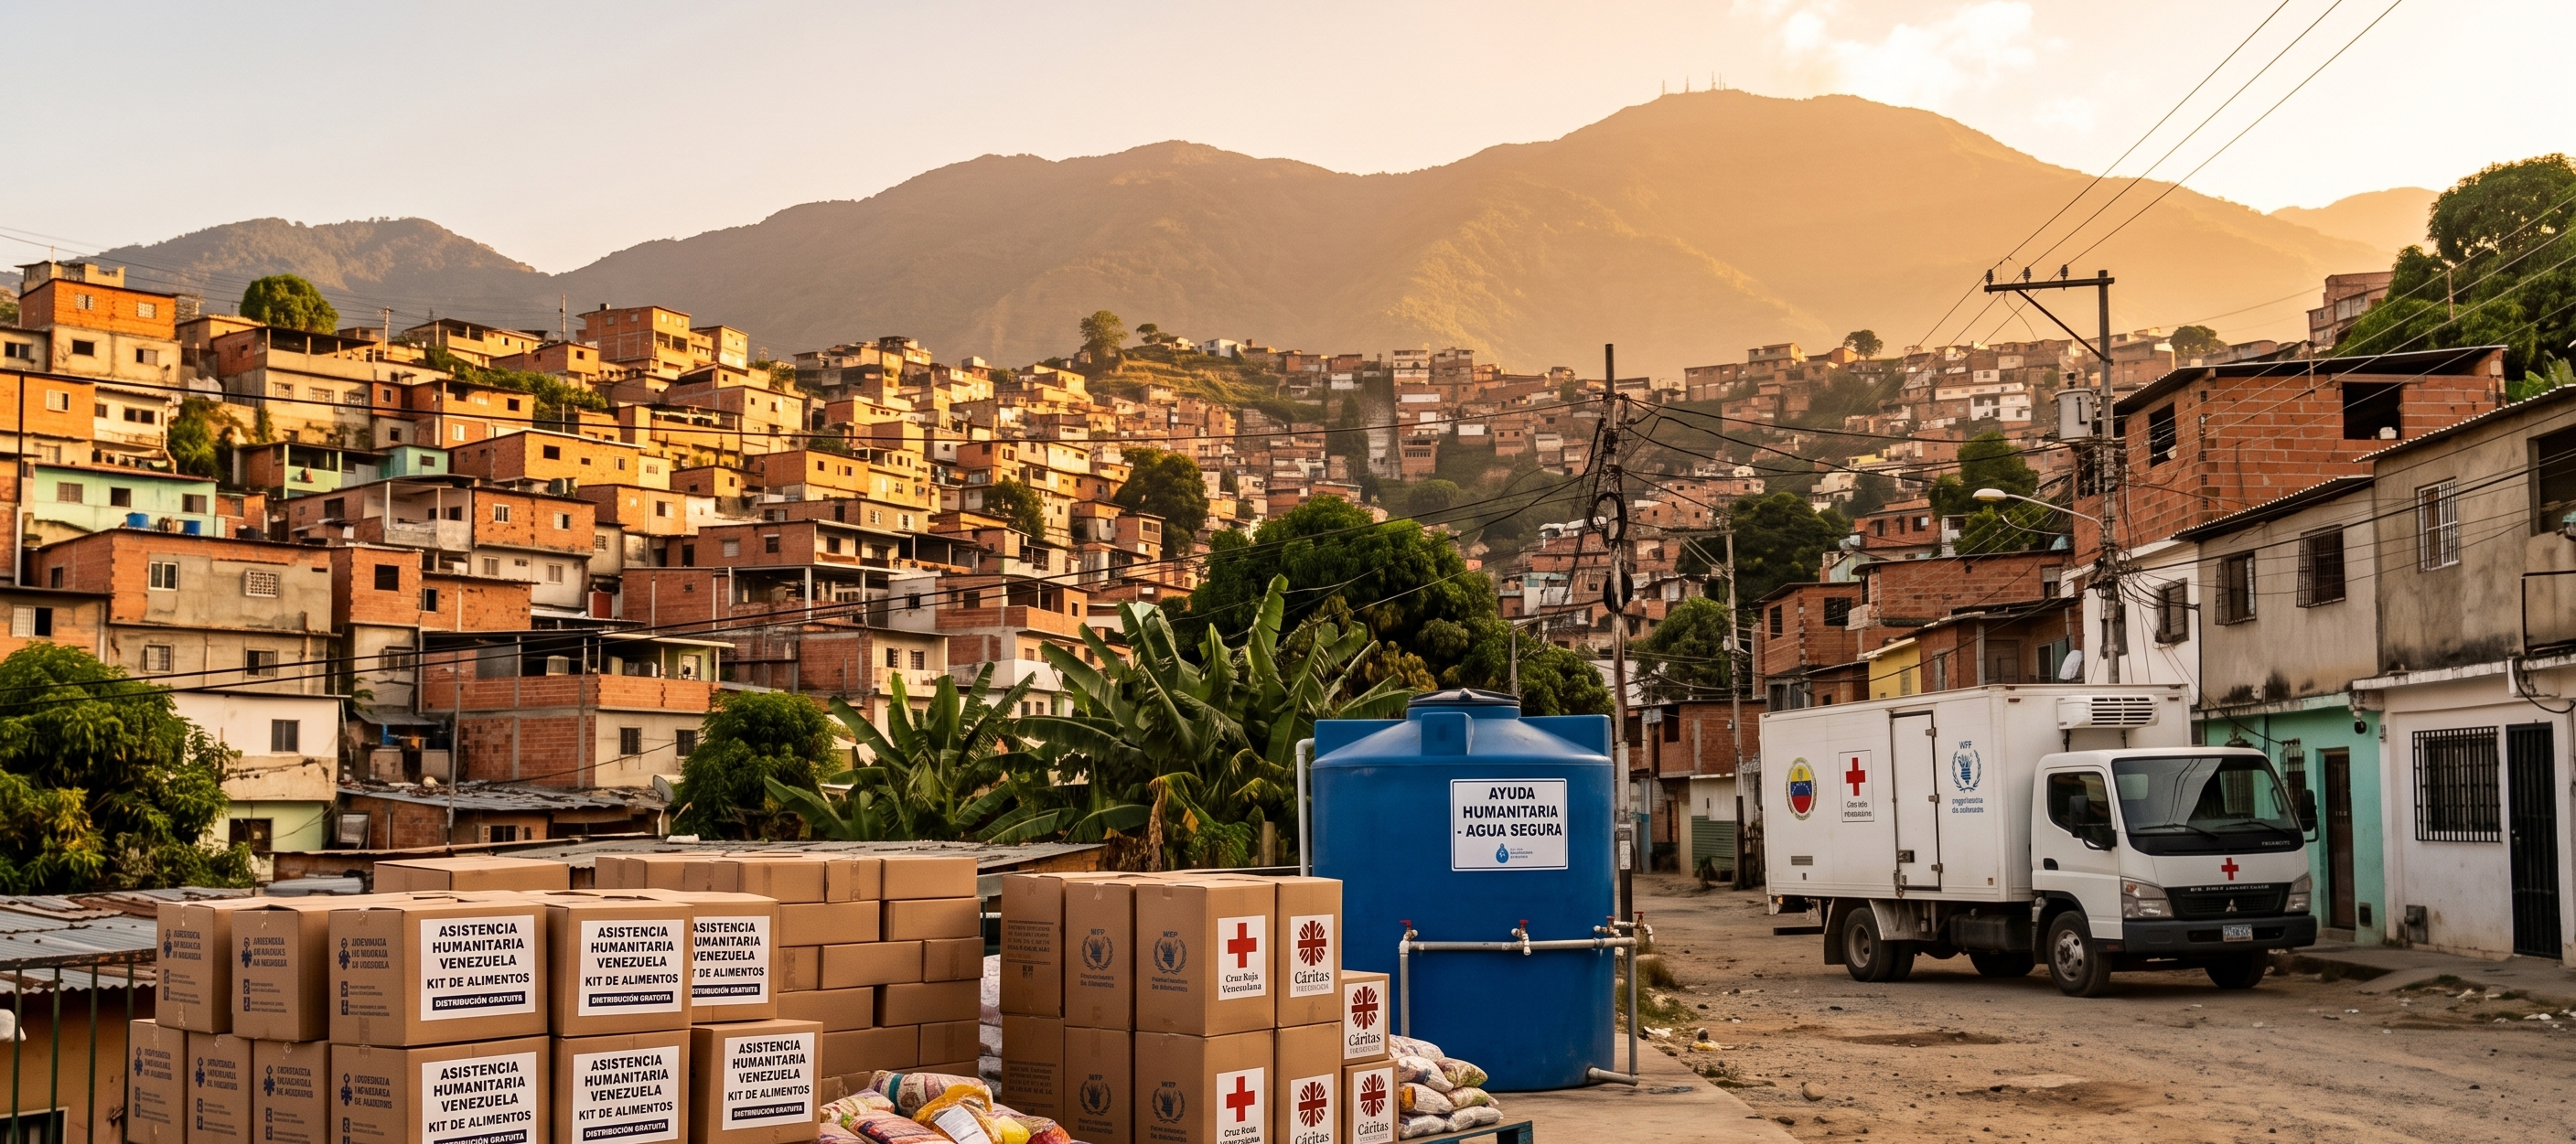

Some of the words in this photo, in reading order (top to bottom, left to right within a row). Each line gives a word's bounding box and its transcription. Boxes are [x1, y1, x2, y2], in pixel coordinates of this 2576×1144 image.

[1488, 786, 1535, 799] AYUDA
[1463, 805, 1558, 818] HUMANITARIA
[1465, 824, 1507, 837] AGUA
[1510, 823, 1562, 836] SEGURA
[439, 923, 517, 936] ASISTENCIA
[598, 926, 668, 938] ASISTENCIA
[693, 923, 756, 933] ASISTENCIA
[432, 938, 524, 953] HUMANITARIA
[591, 941, 673, 953] HUMANITARIA
[694, 936, 761, 946] UMANITARIA
[439, 955, 517, 969] VENEZUELA
[596, 957, 667, 968] VENEZUELA
[693, 951, 756, 961] VENEZUELA
[585, 977, 602, 986] KIT
[606, 976, 618, 986] DE
[622, 973, 679, 985] ALIMENTOS
[699, 968, 711, 978] DE
[714, 968, 765, 977] ALIMENTOS
[1226, 974, 1242, 982] Cruz
[1295, 969, 1330, 984] Cáritas
[426, 978, 445, 989] KIT
[450, 978, 463, 988] DE
[467, 973, 530, 986] ALIMENTOS
[1348, 1032, 1380, 1046] Cáritas
[738, 1040, 800, 1053] ASISTENCIA
[591, 1054, 662, 1071] ASISTENCIA
[732, 1053, 806, 1069] HUMANITARIA
[441, 1061, 519, 1080] ASISTENCIA
[585, 1068, 669, 1086] HUMANITARIA
[738, 1068, 800, 1083] VENEZUELA
[434, 1075, 525, 1097] HUMANITARIA
[591, 1085, 662, 1101] VENEZUELA
[728, 1090, 743, 1101] KIT
[746, 1090, 757, 1099] DE
[759, 1085, 810, 1097] ALIMENTOS
[441, 1094, 519, 1112] VENEZUELA
[578, 1109, 596, 1120] KIT
[598, 1108, 613, 1117] DE
[615, 1101, 673, 1116] ALIMENTOS
[428, 1121, 447, 1132] KIT
[450, 1118, 465, 1129] DE
[468, 1110, 531, 1128] ALIMENTOS
[490, 1132, 525, 1143] GRATUITA
[1224, 1128, 1240, 1138] Cruz
